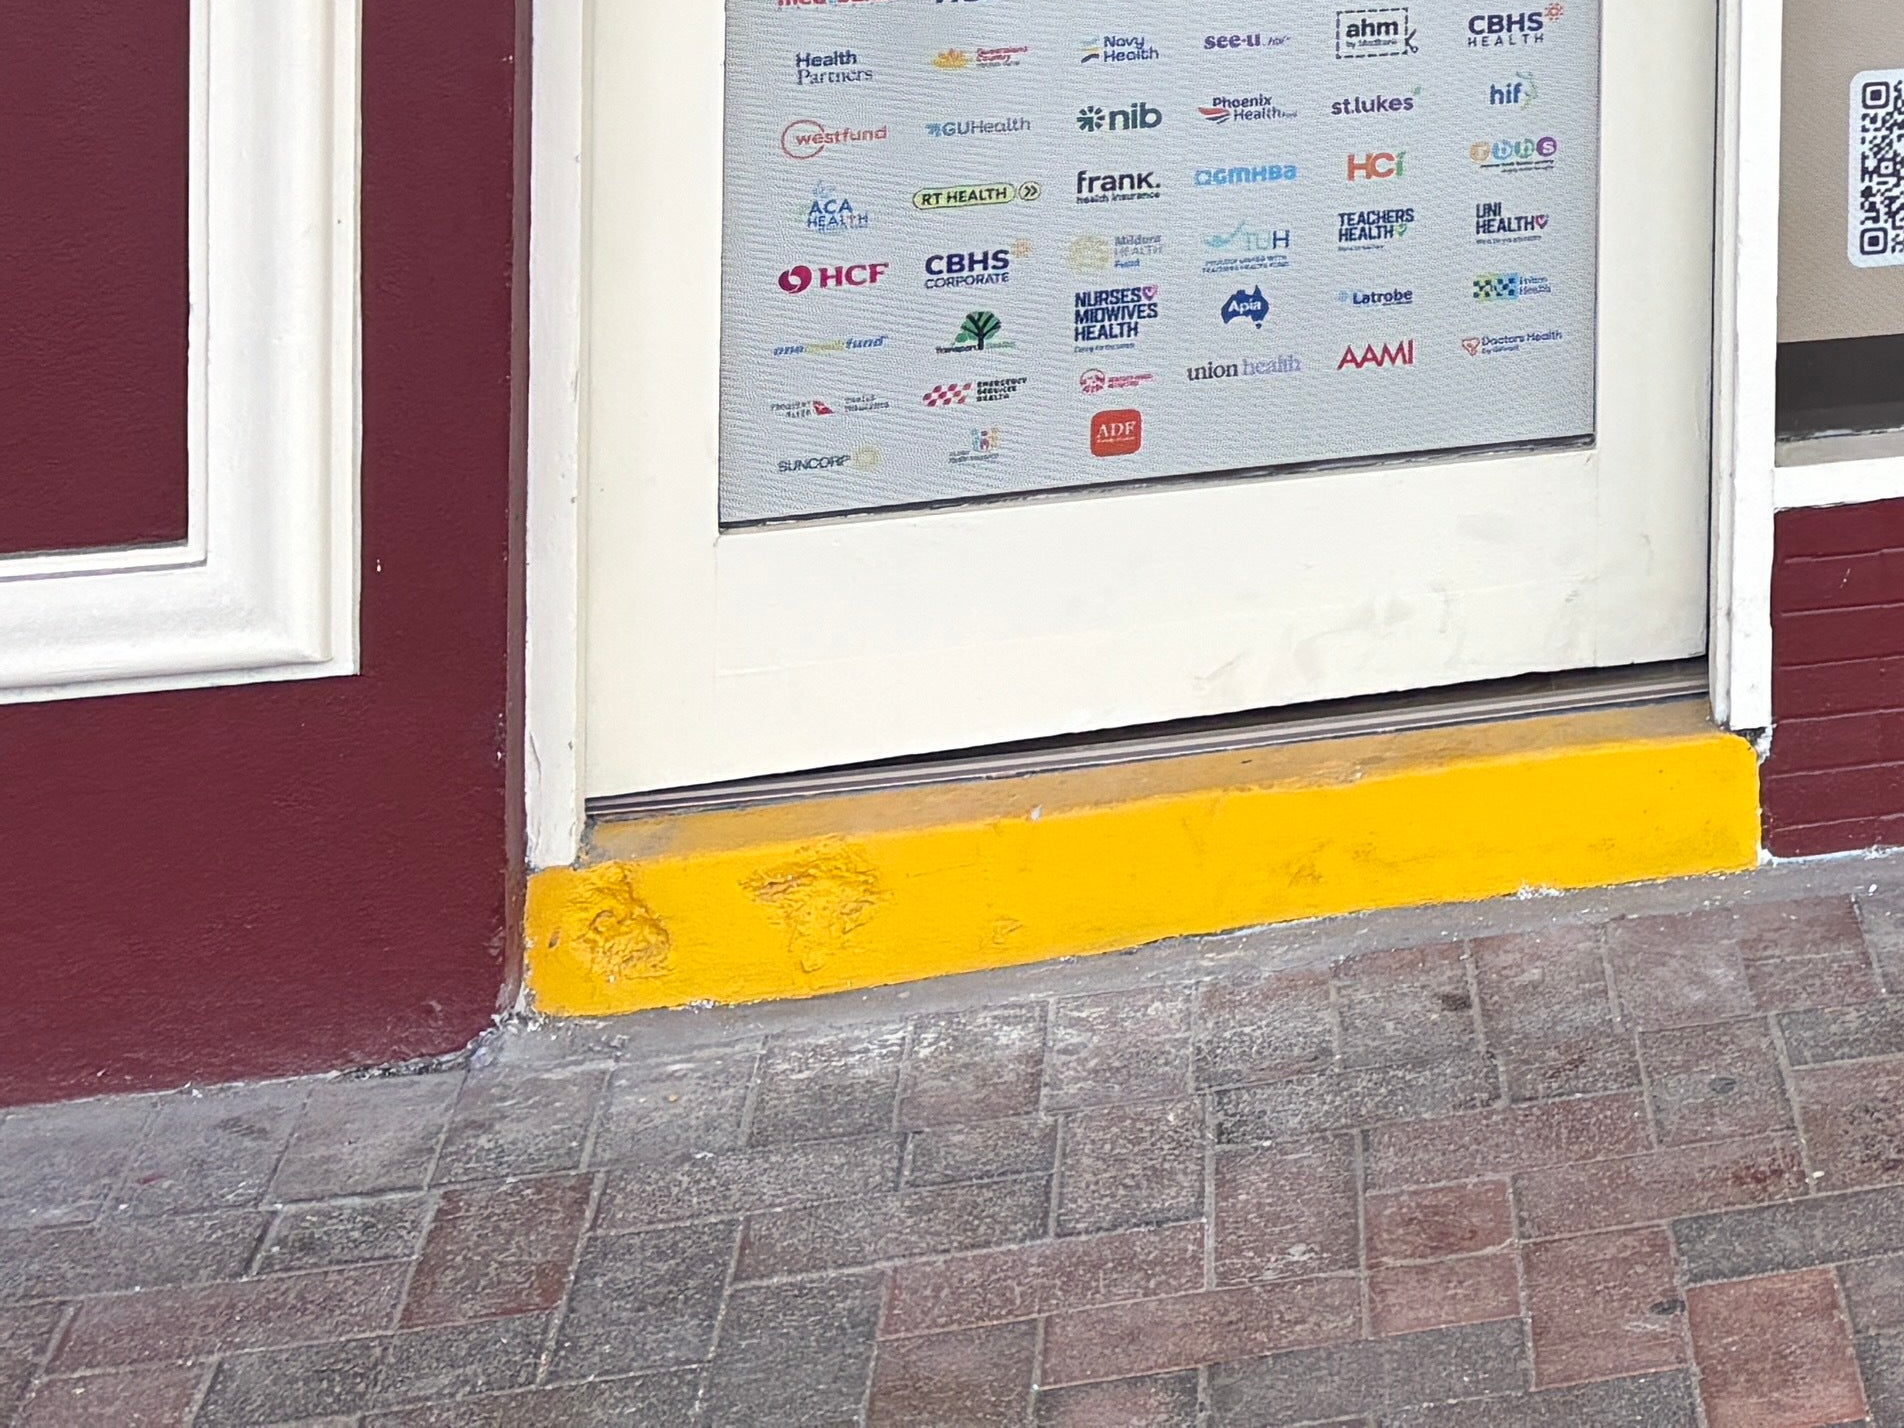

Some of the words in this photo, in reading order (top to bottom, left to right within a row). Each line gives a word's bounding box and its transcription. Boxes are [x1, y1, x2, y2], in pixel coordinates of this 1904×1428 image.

[1346, 18, 1399, 38] ahm
[1468, 12, 1543, 35] CBHS
[1104, 36, 1144, 50] Navy
[1468, 33, 1544, 47] HEALTH
[796, 50, 857, 68] Health
[1104, 47, 1159, 63] Health
[798, 67, 873, 85] Partners
[1212, 95, 1272, 109] Phoenix
[1490, 82, 1522, 105] hif
[1234, 107, 1281, 121] Health
[1331, 95, 1414, 115] st.lukes
[1109, 102, 1162, 131] nib
[795, 126, 887, 145] westfund
[1077, 170, 1161, 194] frank.
[809, 198, 853, 215] ACA
[921, 193, 942, 206] RT
[946, 188, 1007, 203] HEALTH
[1338, 208, 1414, 227] TEACHERS
[1476, 202, 1501, 219] UNI
[807, 213, 868, 228] HEALTH
[1476, 215, 1535, 235] HEALTH
[1338, 224, 1394, 242] HEALTH
[925, 249, 1010, 276] CBHS
[819, 262, 889, 289] HCF
[924, 272, 1010, 290] CORPORATE
[1075, 288, 1142, 308] NURSES
[1353, 289, 1413, 304] Latrobe
[1075, 303, 1158, 325] MIDWIVES
[1228, 298, 1262, 315] Apia
[1075, 322, 1138, 342] HEALTH
[1336, 339, 1414, 371] AAMI
[1187, 360, 1238, 382] union
[1243, 355, 1300, 375] health
